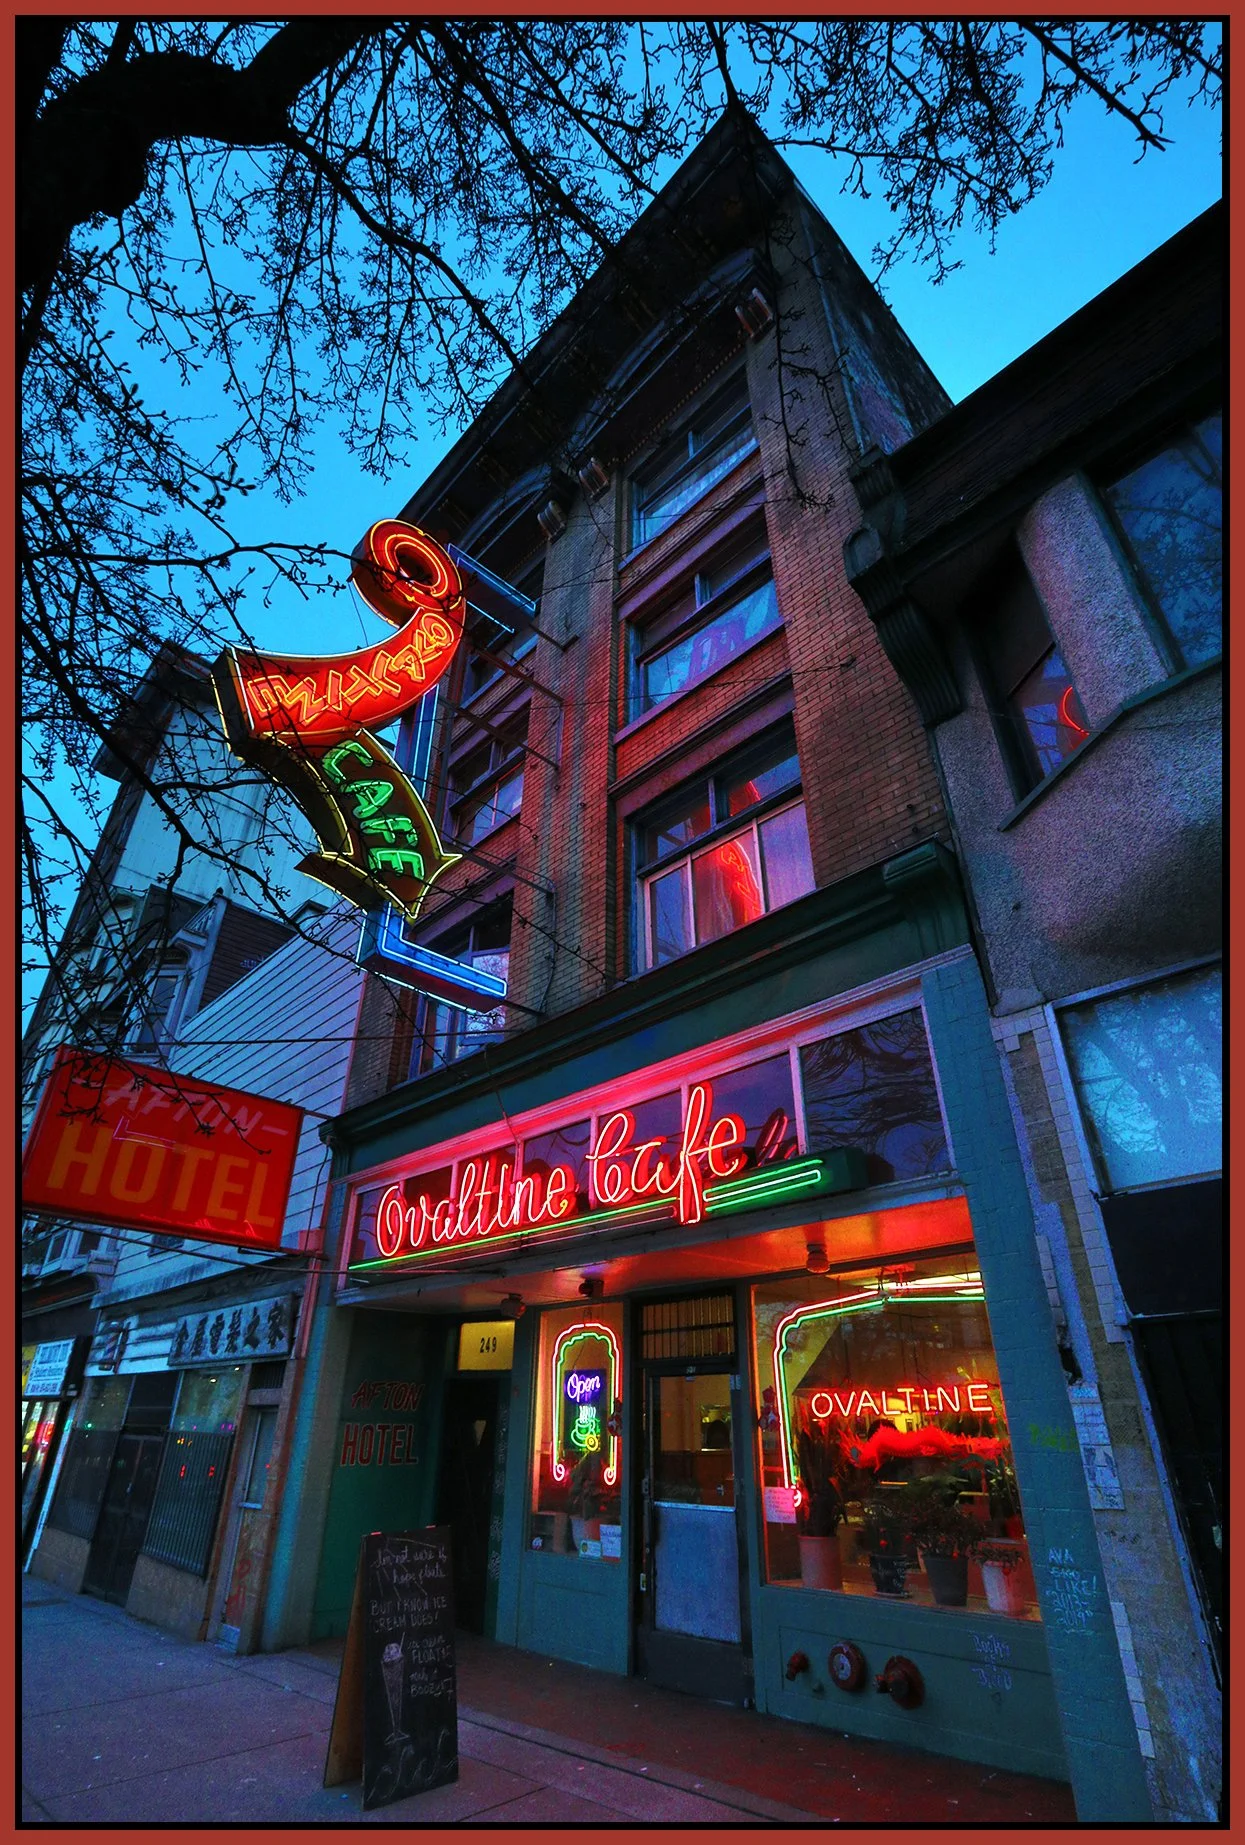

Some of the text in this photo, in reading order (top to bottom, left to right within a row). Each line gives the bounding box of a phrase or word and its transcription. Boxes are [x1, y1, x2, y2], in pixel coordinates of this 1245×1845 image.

[246, 611, 455, 728] OVALTINE
[320, 738, 426, 883] CAFE
[45, 1119, 276, 1229] HOTEL
[376, 1084, 744, 1257] Ovaltine Cafe
[479, 1336, 498, 1354] 249
[351, 1379, 425, 1413] AFTON
[566, 1372, 601, 1403] Open
[811, 1383, 993, 1418] OVALTINE
[339, 1422, 420, 1467] HOTEL
